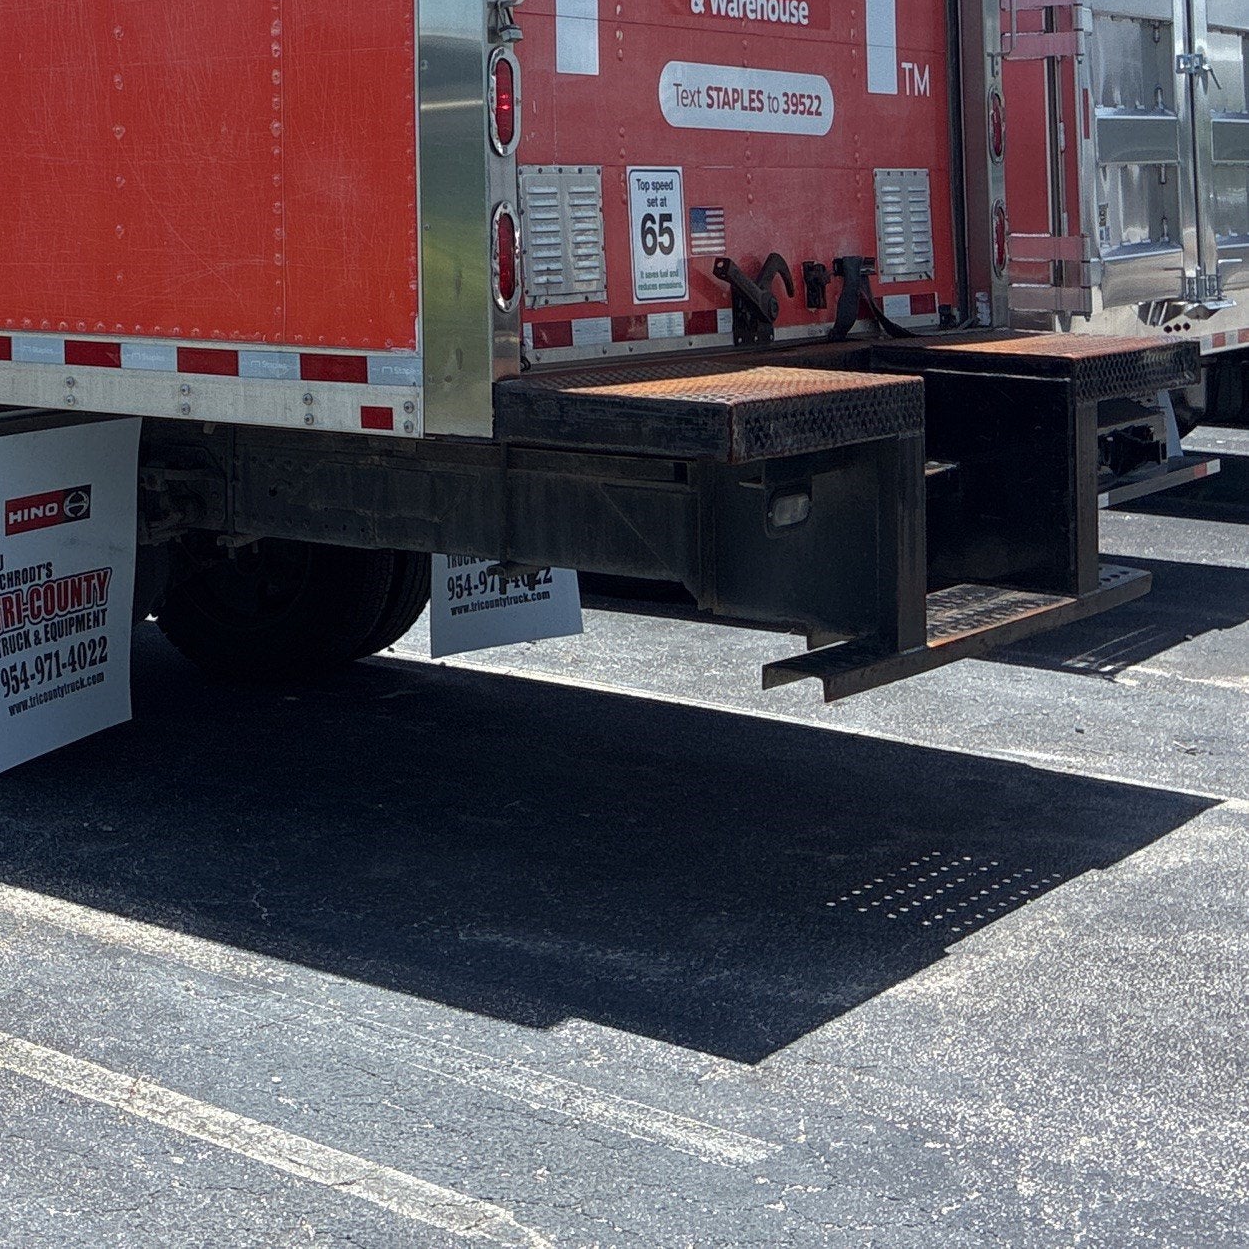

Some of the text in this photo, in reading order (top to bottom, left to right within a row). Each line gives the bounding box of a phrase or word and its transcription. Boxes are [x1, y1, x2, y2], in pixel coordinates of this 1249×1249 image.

[901, 62, 930, 97] TM
[673, 83, 823, 117] Text STAPLES to 39522
[636, 178, 674, 194] Top speed
[647, 195, 668, 208] set at
[641, 213, 675, 256] 65
[8, 503, 58, 525] HINO
[450, 590, 551, 617] www.tricountytruck.com
[34, 630, 43, 647] &
[44, 608, 108, 643] EQUIPMENT
[0, 635, 108, 698] 954-971-4022
[8, 670, 105, 716] www.tricountytruck.com
